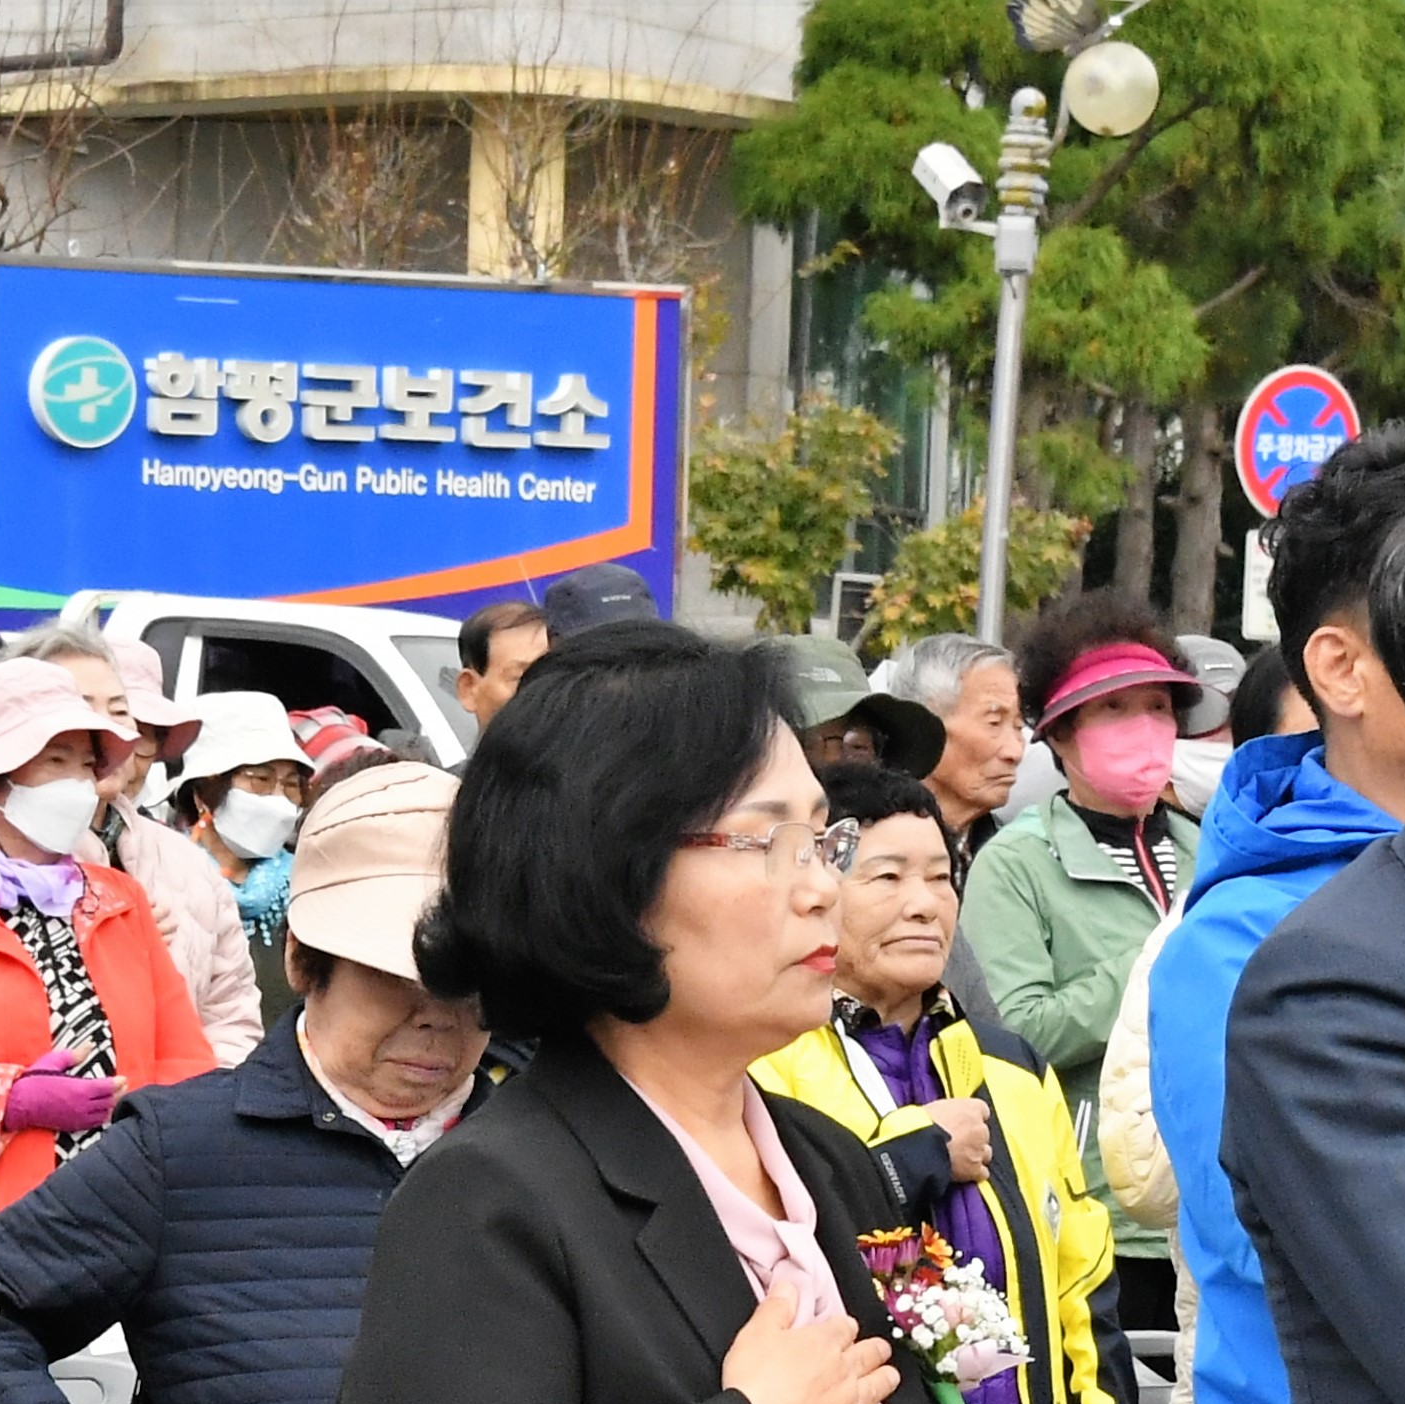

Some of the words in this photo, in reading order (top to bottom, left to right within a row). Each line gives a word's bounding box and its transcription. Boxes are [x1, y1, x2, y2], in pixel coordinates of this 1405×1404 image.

[144, 352, 610, 449] 함평군보건소
[142, 457, 347, 495] Hampyeong-Gun
[355, 464, 428, 497] Public
[436, 468, 510, 499] Health
[518, 472, 596, 504] Center
